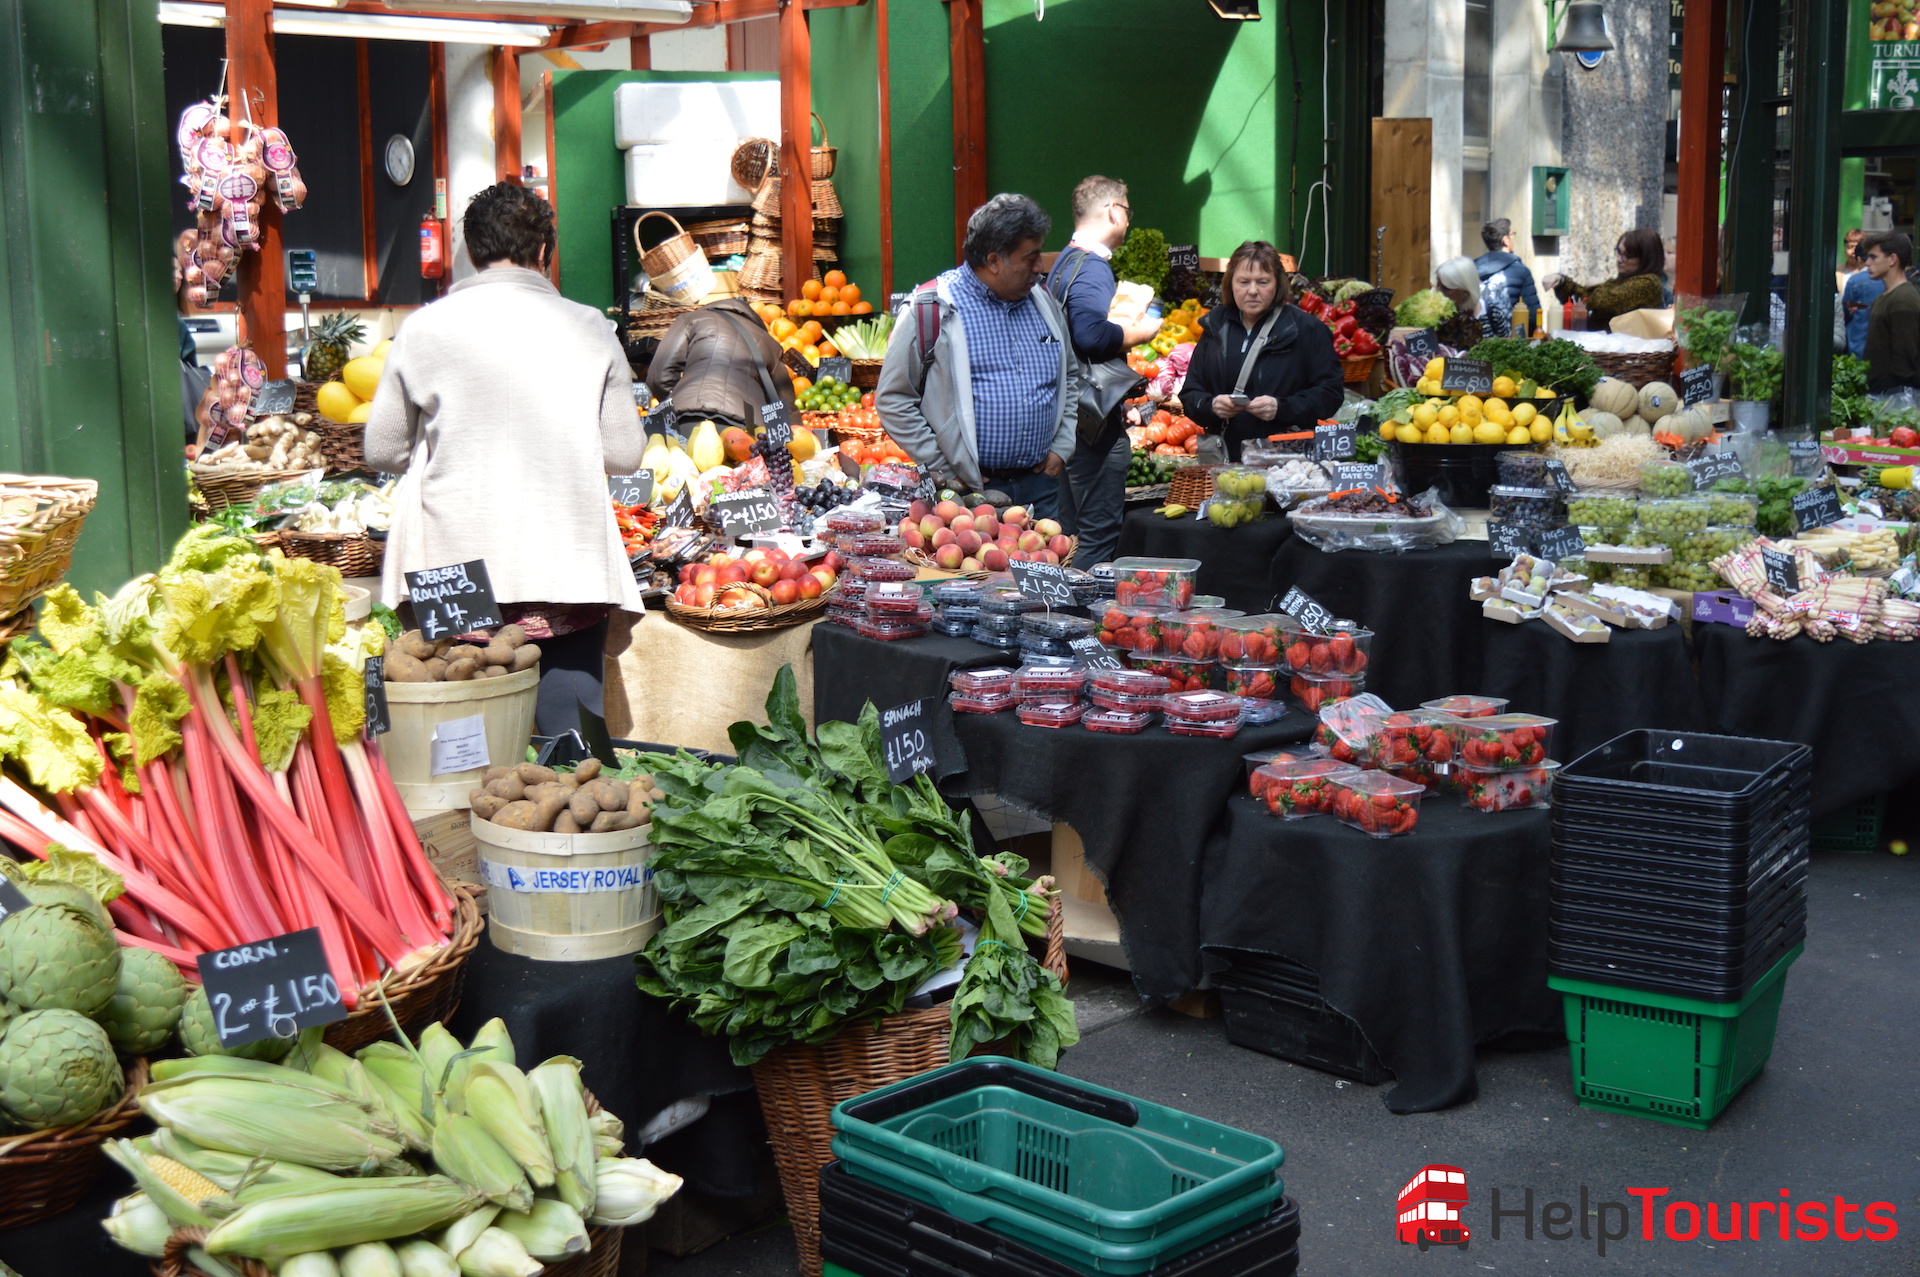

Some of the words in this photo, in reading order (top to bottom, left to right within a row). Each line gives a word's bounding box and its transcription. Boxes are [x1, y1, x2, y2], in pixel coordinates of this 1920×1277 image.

[1672, 1, 1684, 17] Tr
[721, 510, 736, 529] 2
[1490, 524, 1499, 533] 2
[1493, 542, 1502, 552] 2
[416, 563, 469, 587] JERSEY
[1009, 559, 1065, 580] BLUEBERRY
[883, 700, 922, 728] SPINACH
[533, 870, 591, 889] JERSEY
[593, 866, 641, 889] ROYAL
[213, 992, 250, 1041] 2
